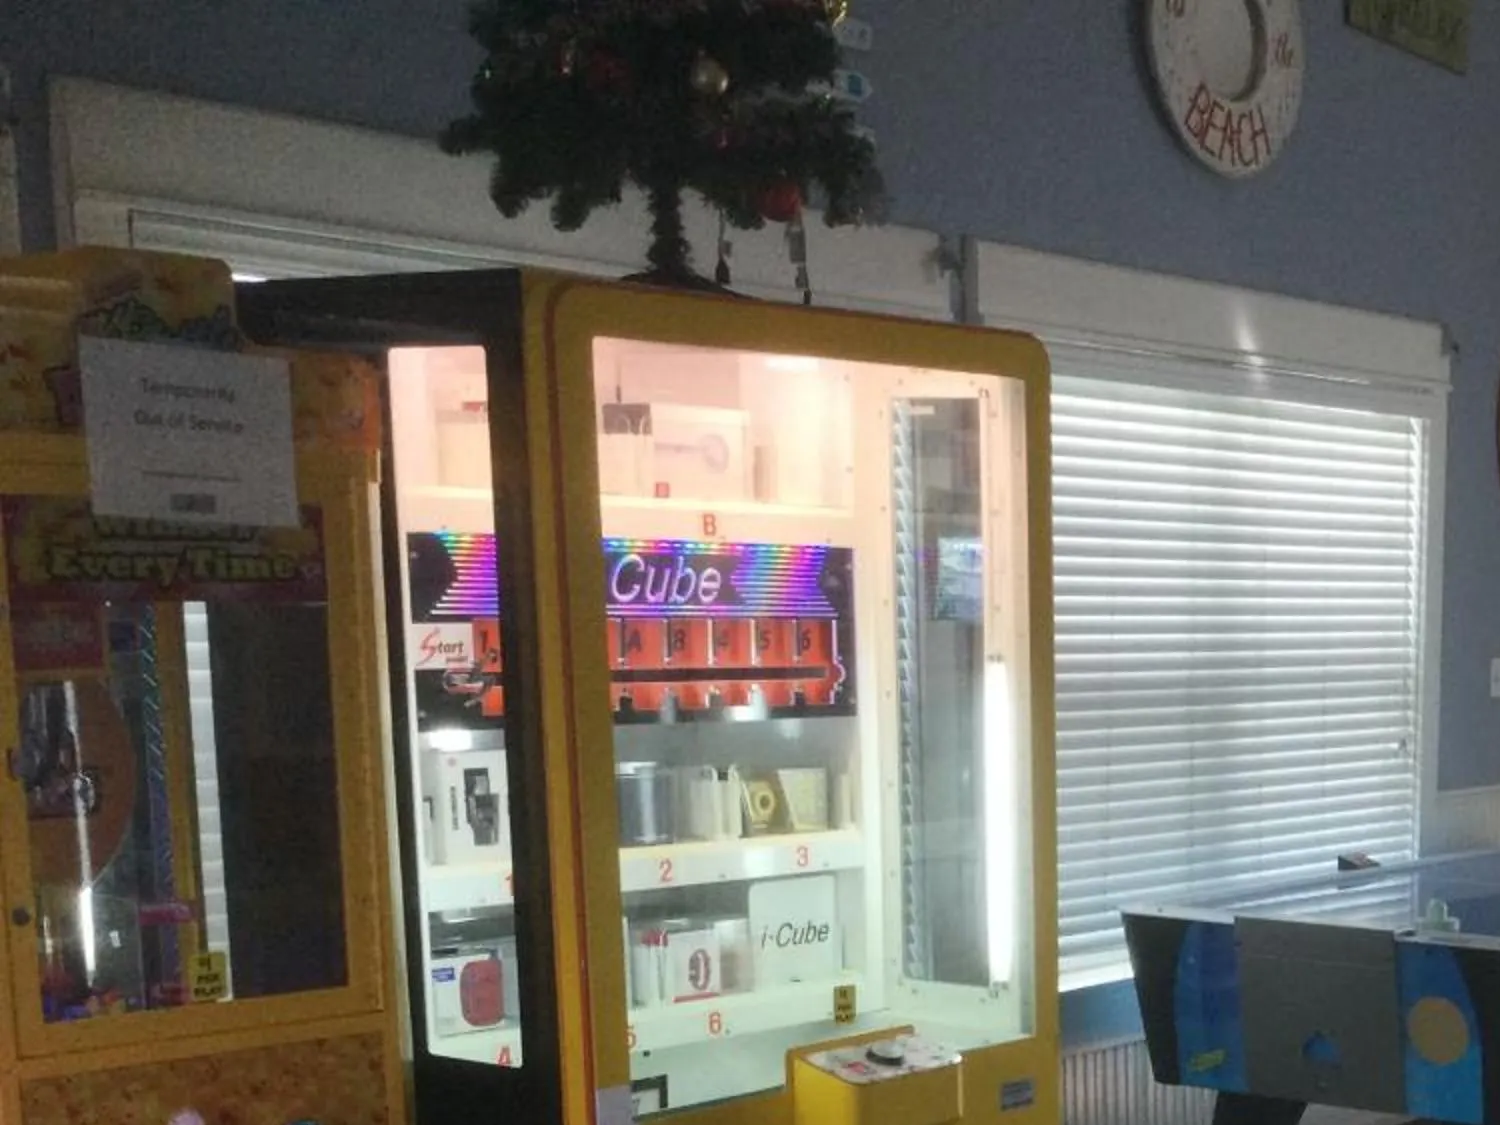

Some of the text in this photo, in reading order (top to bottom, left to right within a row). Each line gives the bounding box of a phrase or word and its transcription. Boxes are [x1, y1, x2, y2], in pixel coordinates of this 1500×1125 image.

[1185, 84, 1271, 166] BEACH
[702, 513, 717, 537] B
[47, 546, 299, 588] Every Time
[611, 553, 722, 603] Cube
[416, 626, 464, 667] Start
[658, 858, 673, 883] 2
[796, 845, 809, 868] 3
[708, 1011, 722, 1035] 6
